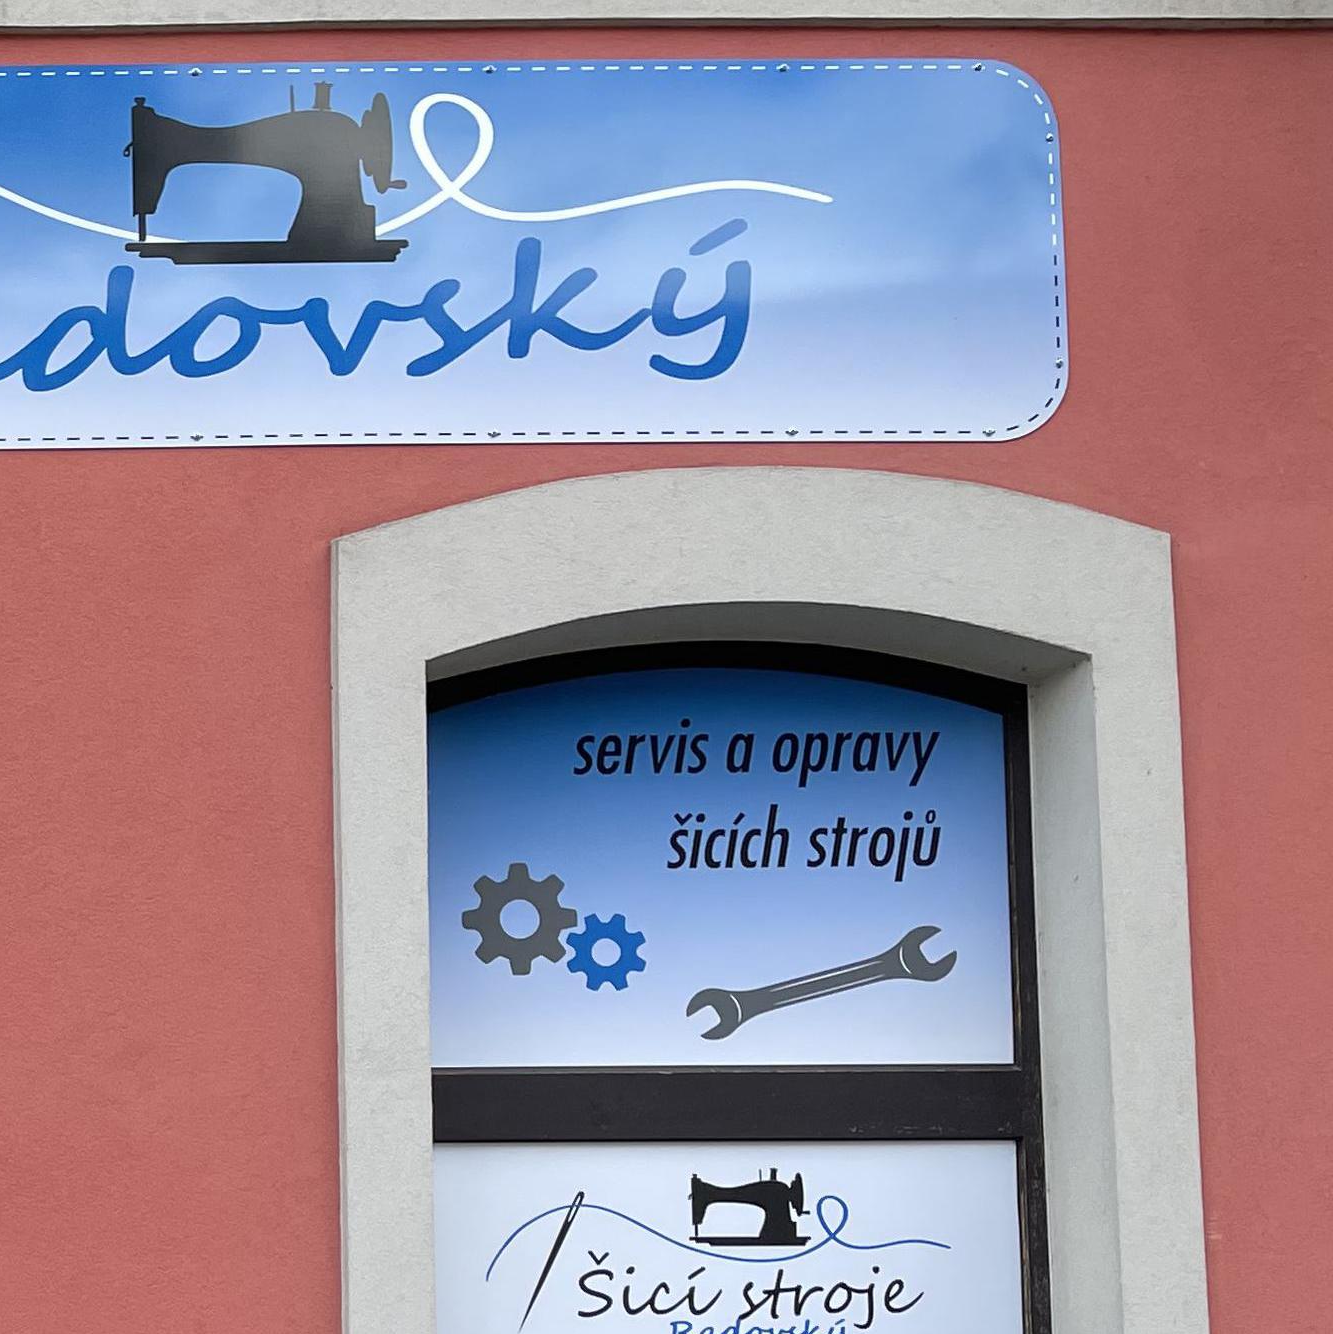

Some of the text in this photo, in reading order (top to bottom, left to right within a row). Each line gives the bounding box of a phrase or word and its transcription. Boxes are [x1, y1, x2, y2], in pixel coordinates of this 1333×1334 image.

[573, 718, 940, 788] servis a opravy
[667, 803, 941, 882] šicích strojů
[577, 1250, 925, 1330] Šicí stroje
